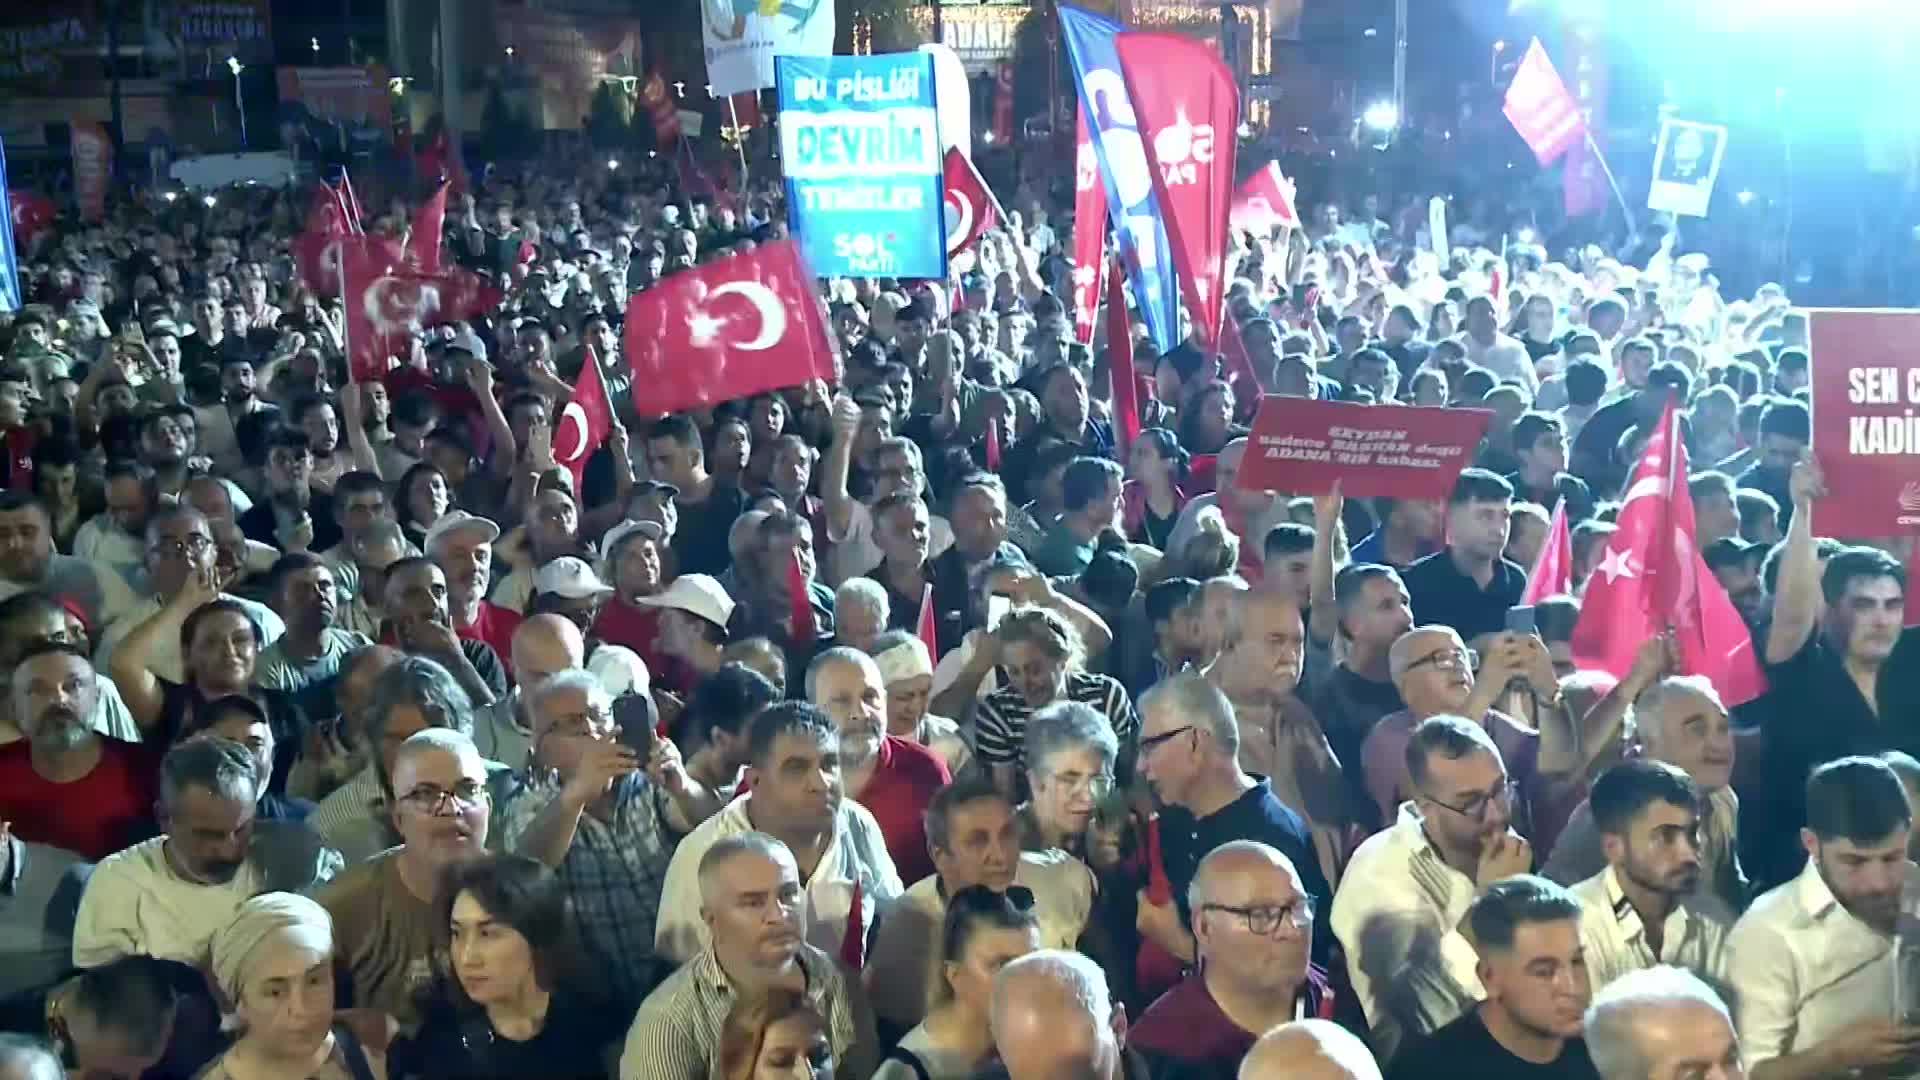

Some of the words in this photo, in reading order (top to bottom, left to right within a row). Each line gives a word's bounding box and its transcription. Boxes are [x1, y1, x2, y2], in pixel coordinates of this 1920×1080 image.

[794, 77, 827, 101] BU
[796, 112, 924, 164] DEVRİM
[1848, 367, 1900, 404] SEN
